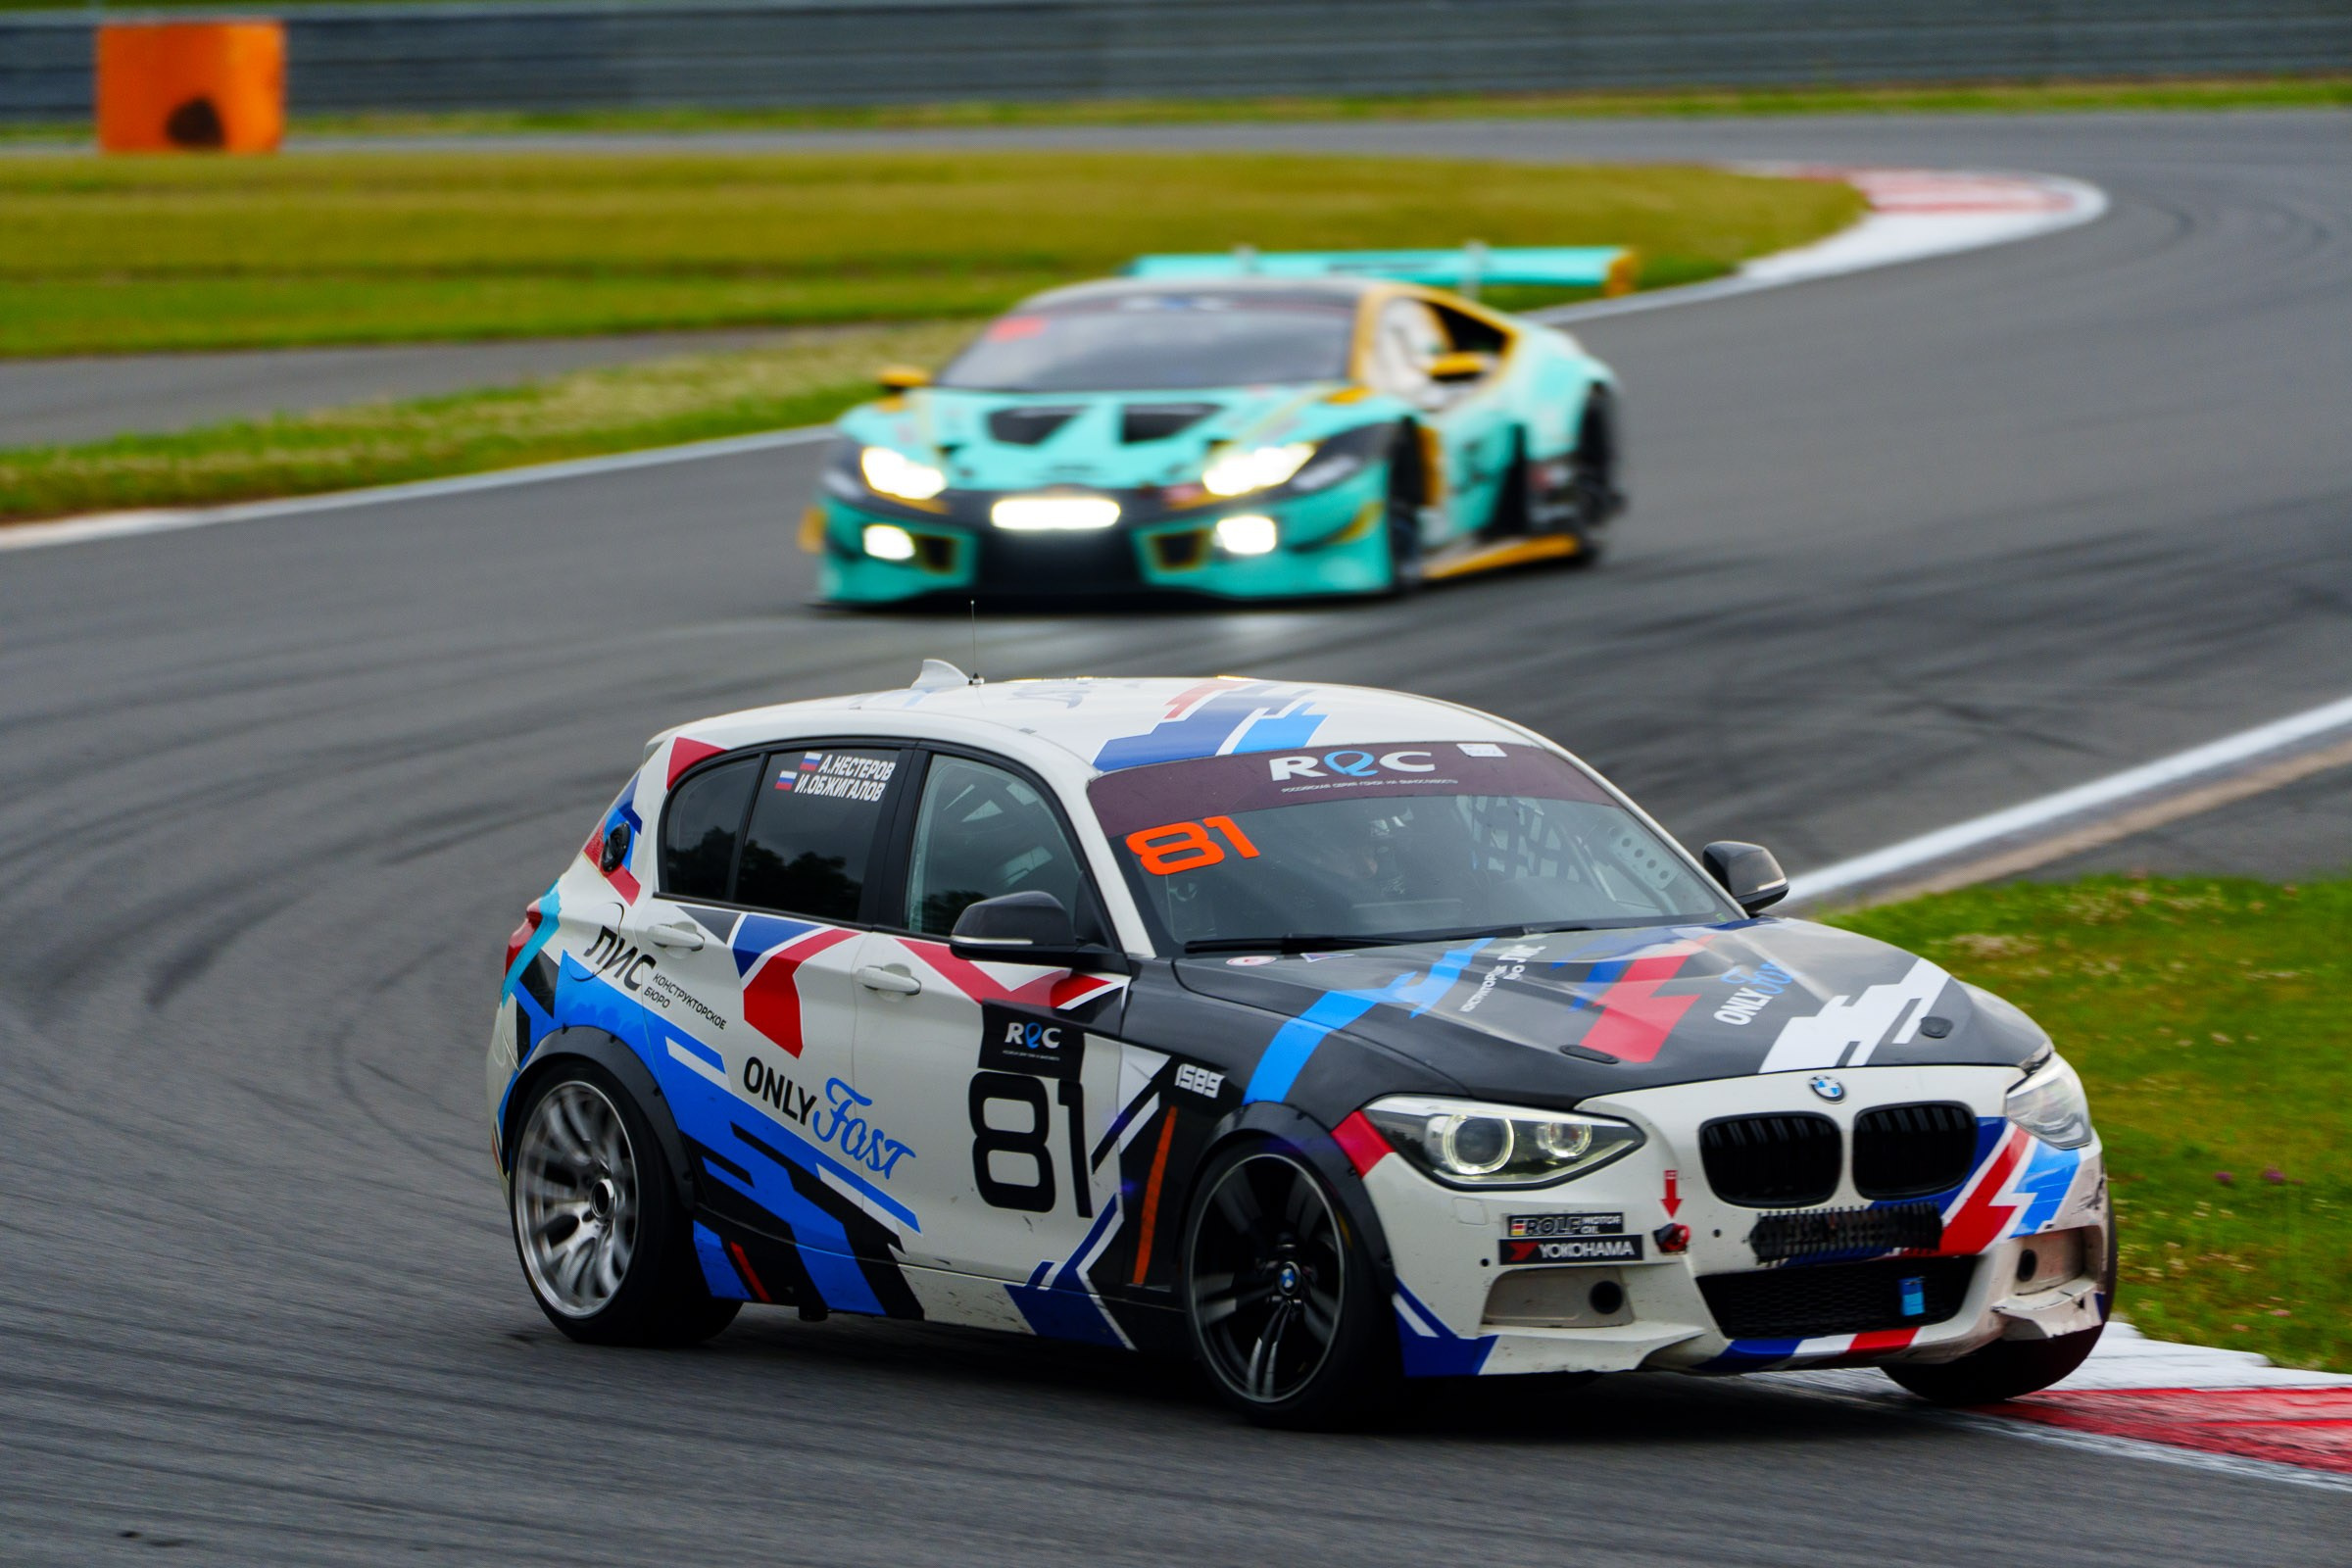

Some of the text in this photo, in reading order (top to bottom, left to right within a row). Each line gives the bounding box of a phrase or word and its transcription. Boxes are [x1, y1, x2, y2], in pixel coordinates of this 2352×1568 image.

[817, 754, 897, 781] А.НЕСТЕРОВ
[794, 773, 887, 802] И.ОБЖИГАЛОВ
[1125, 815, 1260, 876] 81
[643, 985, 671, 1009] БЮРО
[653, 972, 727, 1031] КОНСТРУКТОРСКОЕ
[1713, 986, 1774, 1026] ONLY
[743, 1055, 818, 1127] ONLY
[967, 1070, 1094, 1219] 81
[1526, 1218, 1582, 1236] ROLF
[1540, 1241, 1635, 1258] YOKOHAMA
